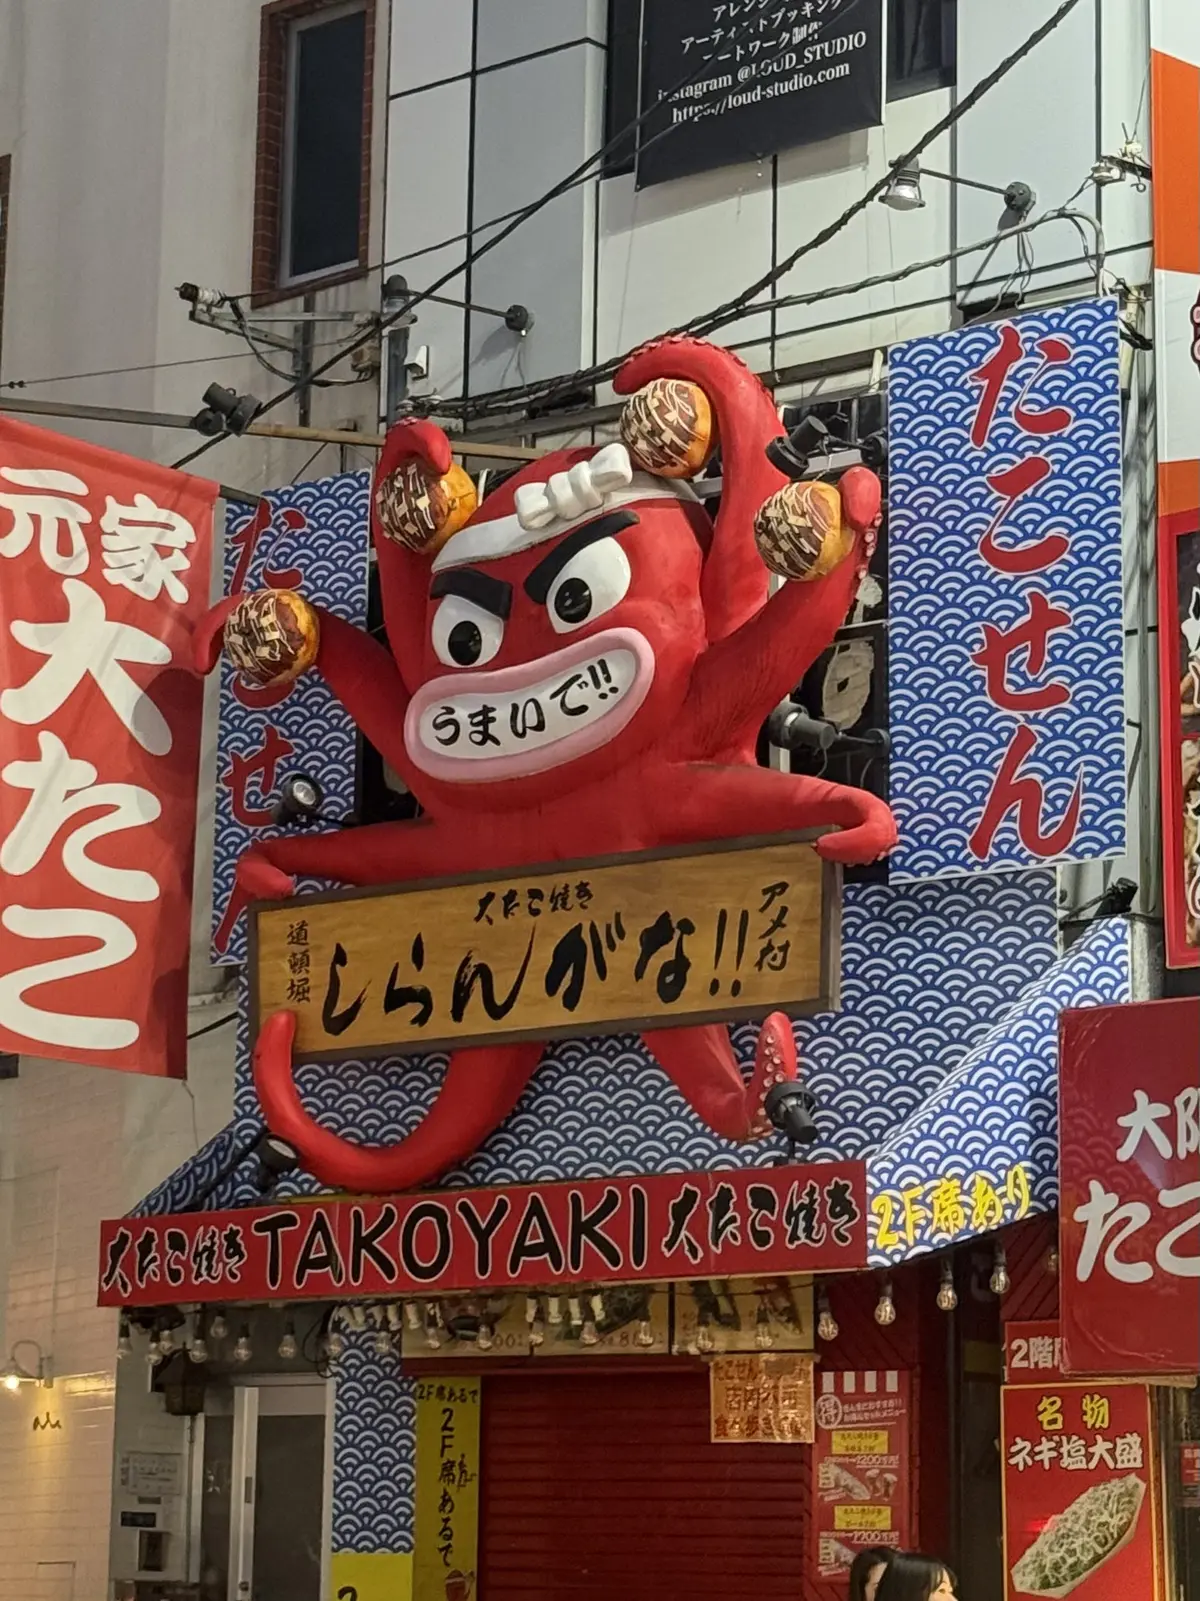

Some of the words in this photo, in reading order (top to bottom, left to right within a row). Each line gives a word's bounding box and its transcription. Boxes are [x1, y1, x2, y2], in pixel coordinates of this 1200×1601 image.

[672, 62, 850, 123] https://loud-studio.com
[967, 321, 1085, 862] たこせん
[286, 920, 311, 1003] 道頓堀
[753, 881, 791, 972] アメ村
[251, 1184, 648, 1291] TAKOYAKI
[661, 1177, 861, 1265] 大たこ焼き
[871, 1164, 1032, 1250] 2F席あり
[1008, 1432, 1143, 1472] ネギ塩大盛
